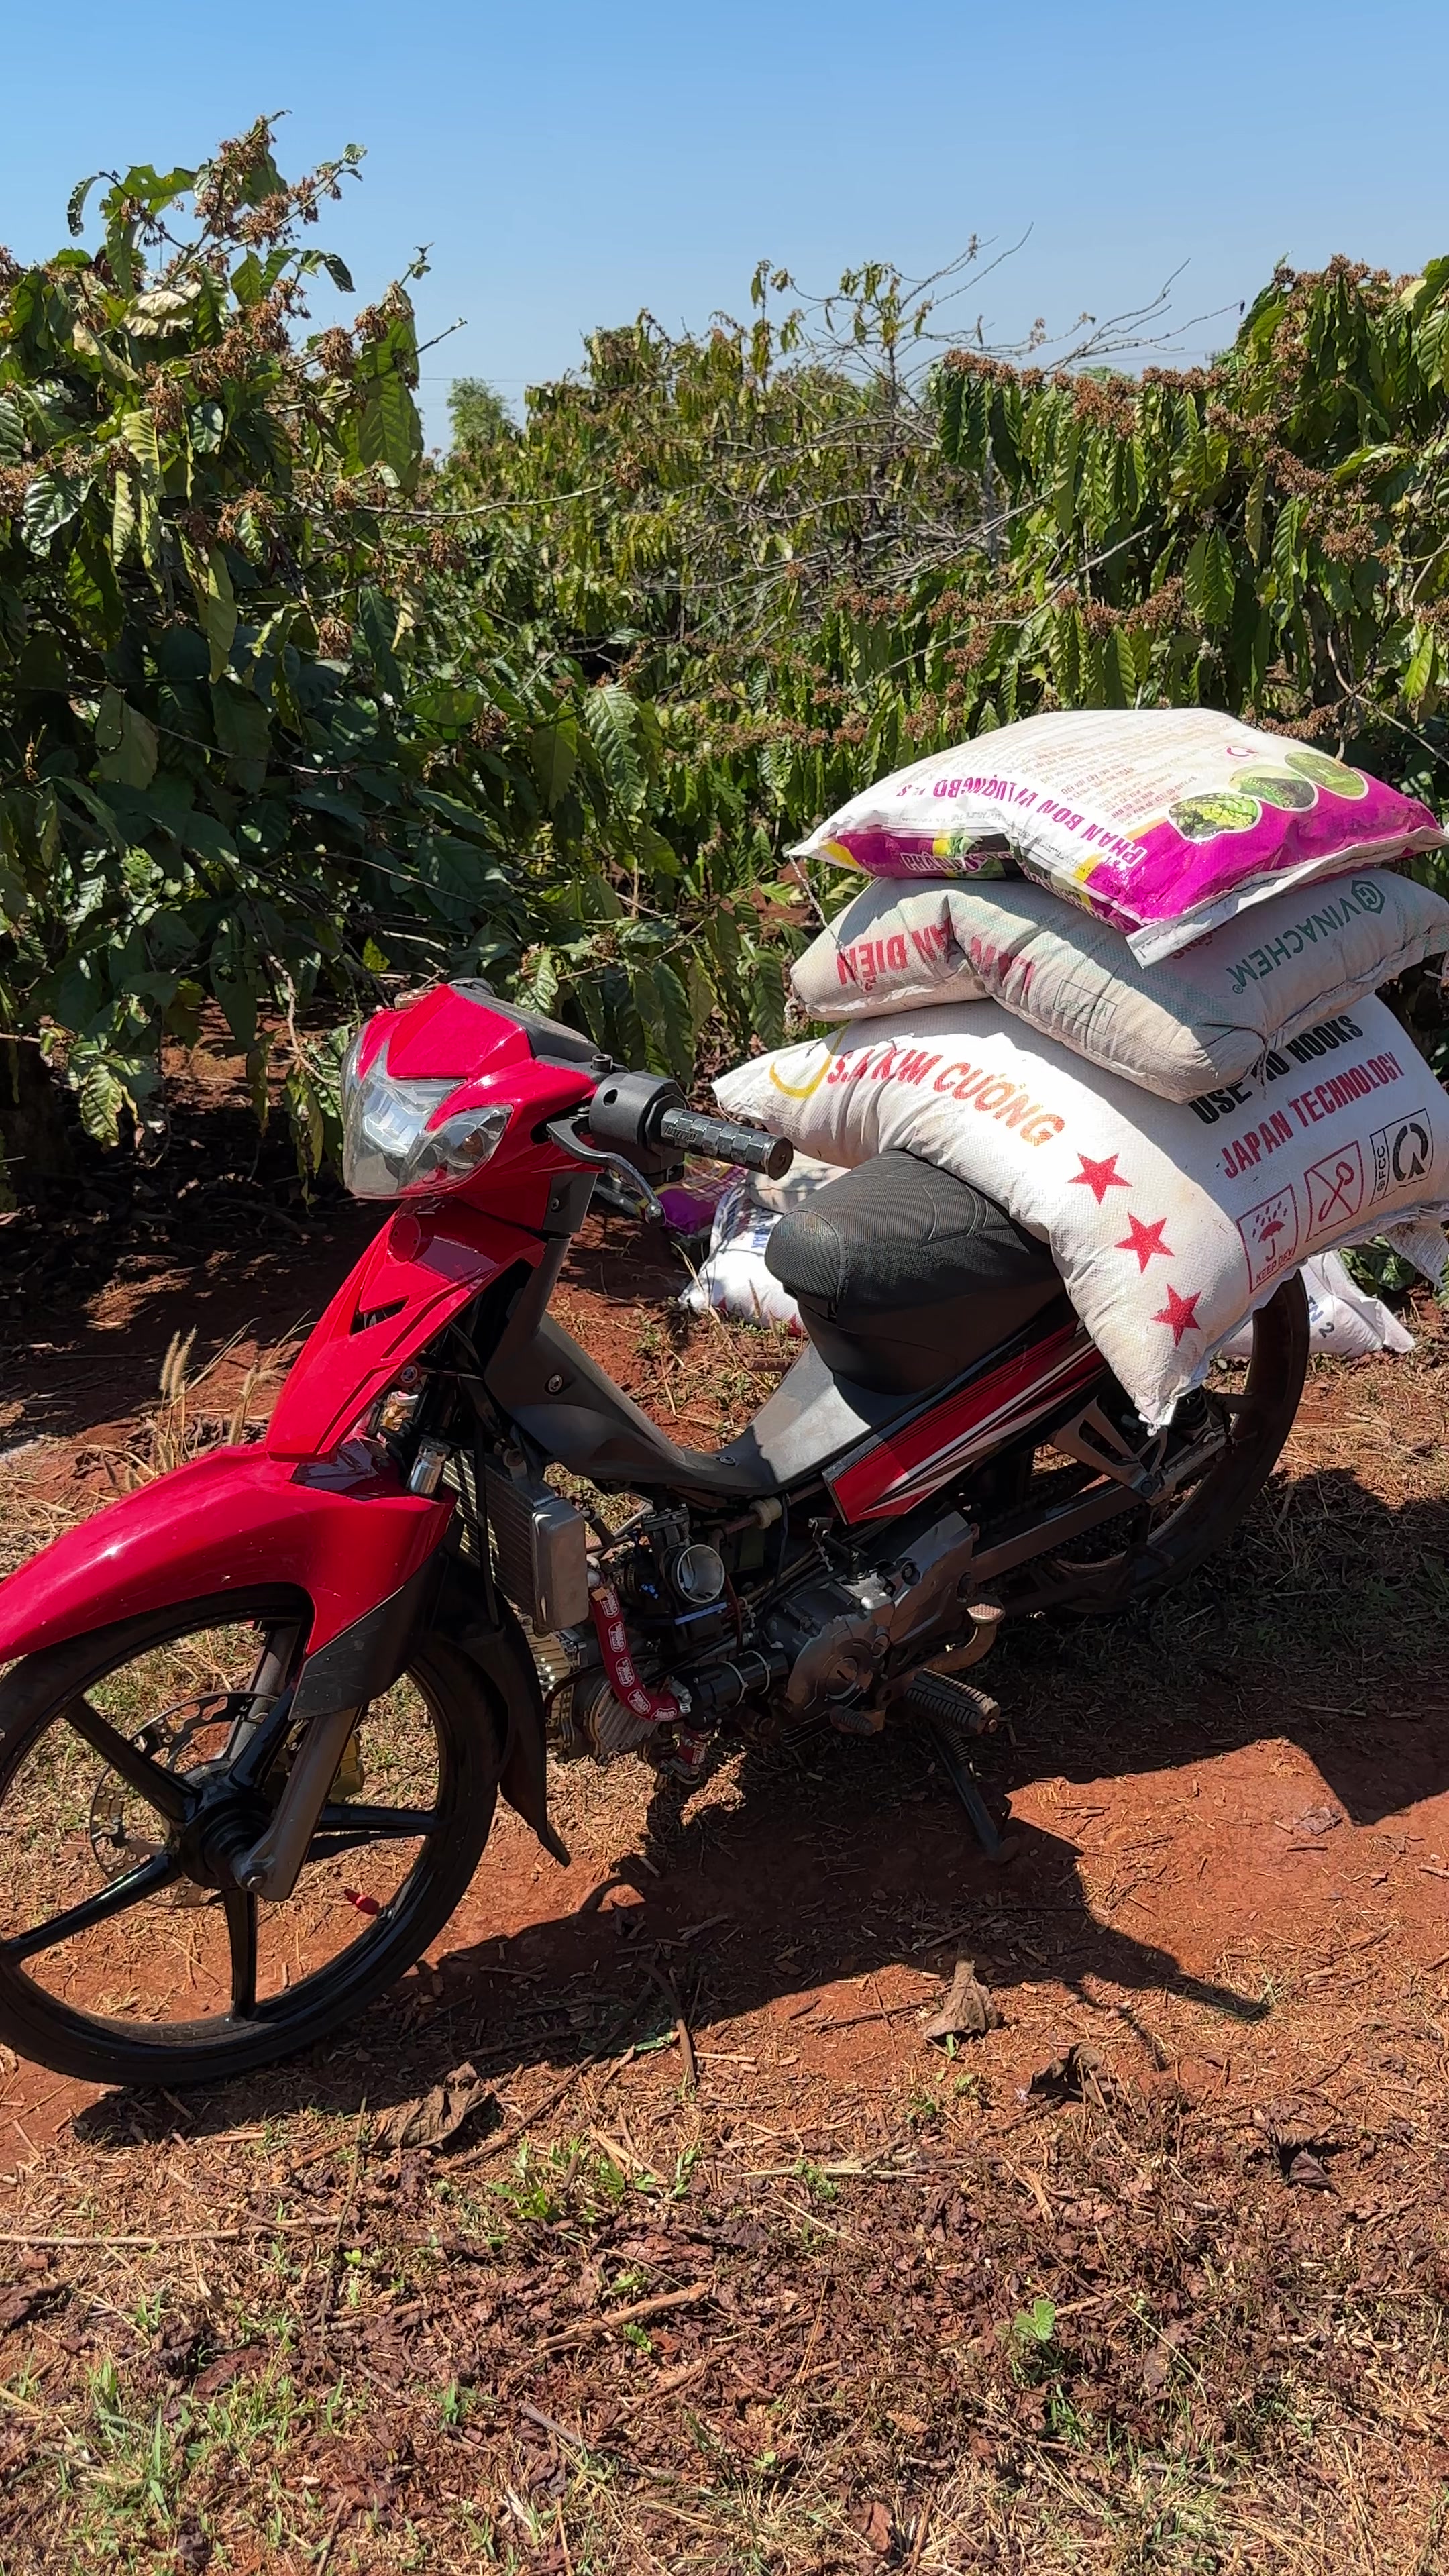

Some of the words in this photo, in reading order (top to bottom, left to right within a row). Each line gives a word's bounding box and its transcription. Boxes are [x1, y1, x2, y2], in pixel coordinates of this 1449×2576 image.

[1188, 1081, 1252, 1124] USE
[1285, 1014, 1364, 1064] HOOKS
[1220, 1109, 1295, 1179] JAPAN
[1288, 1051, 1405, 1128] TECHNOLOGY
[1256, 1260, 1277, 1284] KEEP
